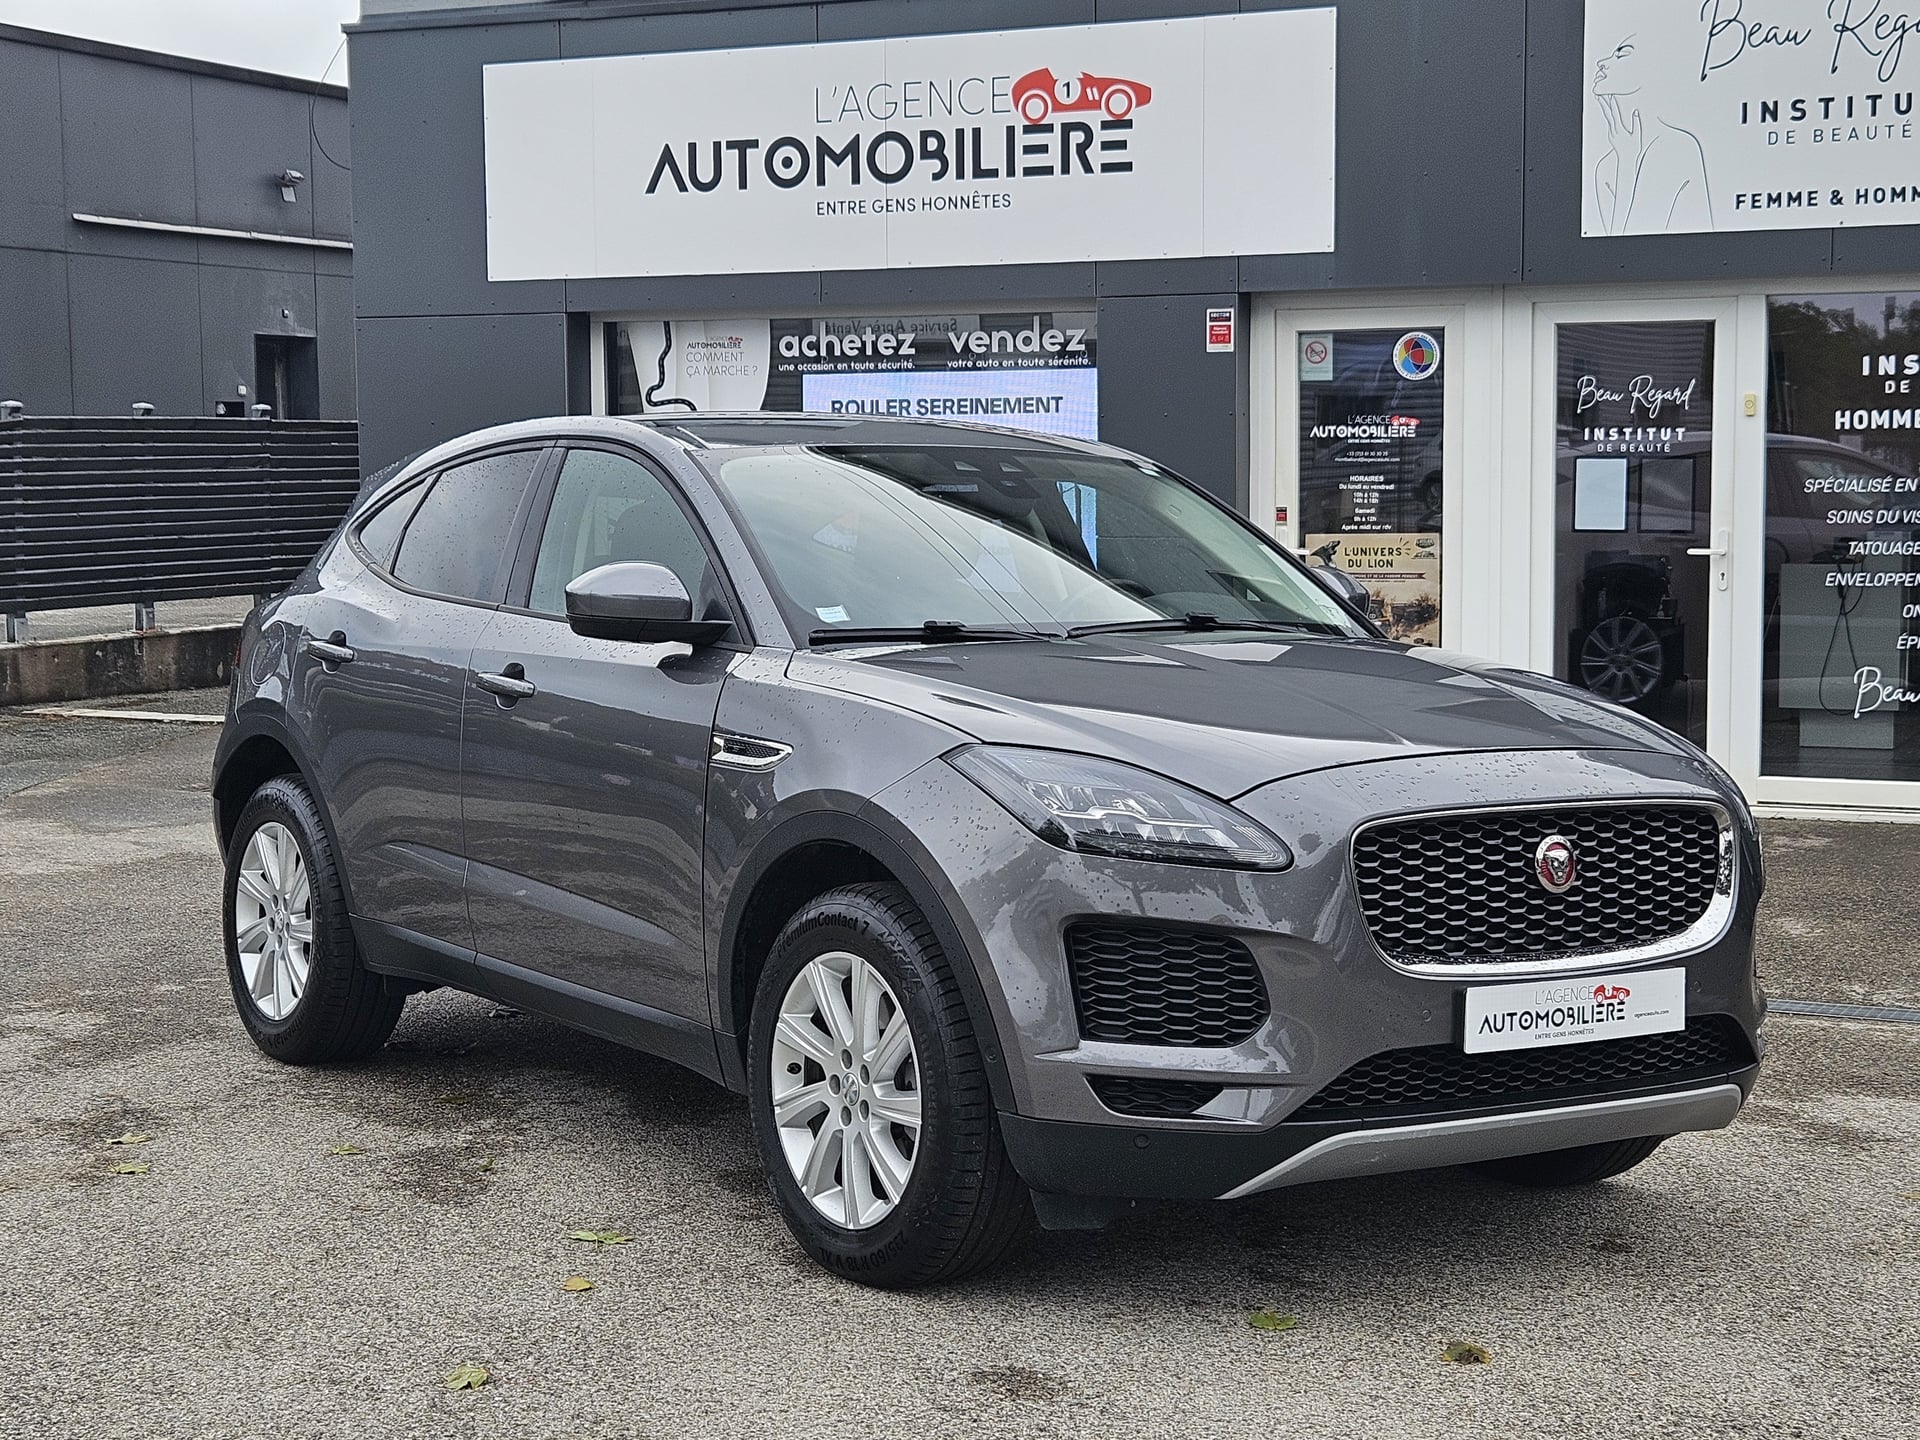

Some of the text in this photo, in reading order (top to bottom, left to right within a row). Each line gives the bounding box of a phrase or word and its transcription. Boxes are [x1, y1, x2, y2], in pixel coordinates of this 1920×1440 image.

[1700, 0, 1811, 82] Beau
[814, 75, 1011, 124] L'AGENCE
[1741, 92, 1913, 125] INSTITU
[1768, 119, 1912, 145] DE BEAUTÉ
[816, 191, 1012, 216] ENTRE GENS HONNÊTES
[1735, 190, 1819, 210] FEMME
[1830, 190, 1844, 206] &
[779, 321, 916, 357] achetez
[948, 316, 1086, 353] vendez
[686, 352, 744, 362] COMMENT
[779, 363, 794, 371] une
[797, 360, 834, 371] occasion
[837, 362, 848, 370] en
[851, 361, 874, 370] toute
[947, 360, 973, 368] votre
[976, 359, 999, 367] auto
[1018, 358, 1044, 367] toute
[1862, 354, 1920, 376] INS
[686, 365, 758, 378] ÇA MARCHE ?
[1577, 374, 1696, 419] Beau Regard
[1885, 379, 1911, 394] DE
[831, 396, 1063, 416] ROULER SEREINEMENT
[1347, 415, 1391, 424] L'AGENCE
[1584, 427, 1686, 441] INSTITUT
[1597, 442, 1671, 452] DE BEAUTÉ
[1803, 475, 1918, 493] SPÉCIALISÉ EN
[1826, 510, 1874, 524] SOINS
[1876, 510, 1900, 524] DU
[1344, 547, 1402, 557] L'UNIVERS
[1348, 559, 1394, 568] DU LION
[1853, 666, 1920, 719] Beau
[1535, 985, 1594, 1005] L'AGENCE
